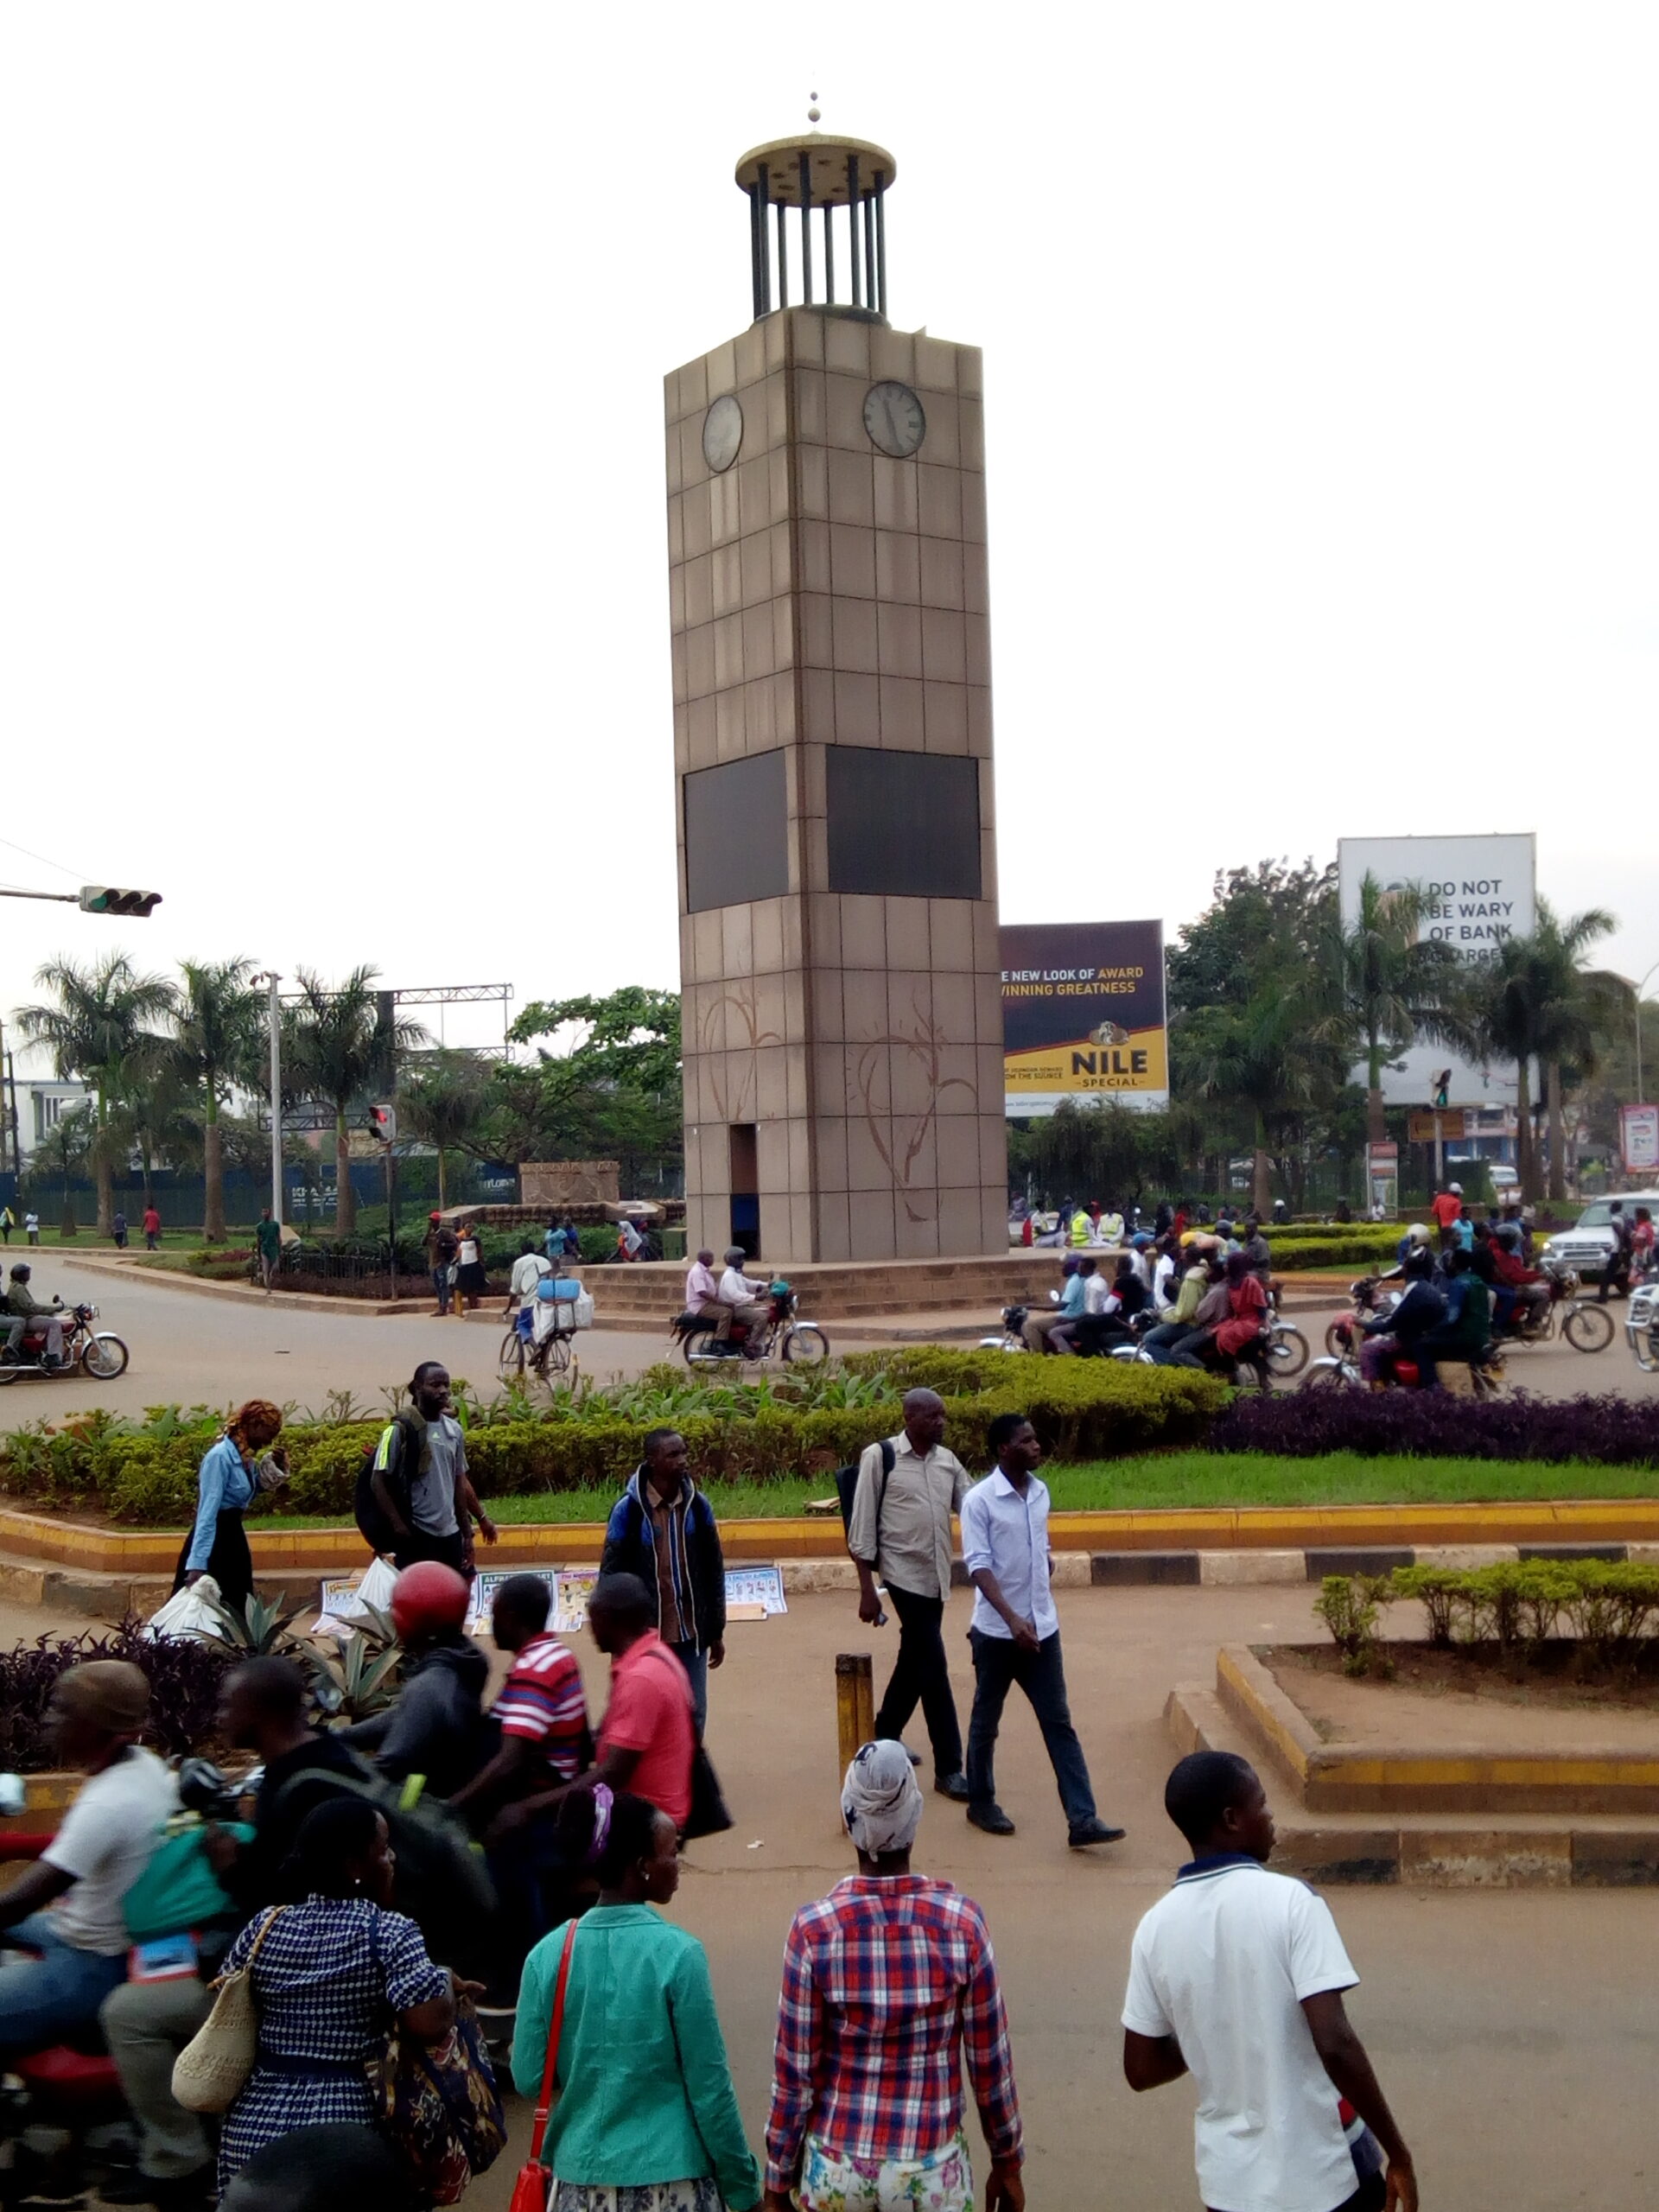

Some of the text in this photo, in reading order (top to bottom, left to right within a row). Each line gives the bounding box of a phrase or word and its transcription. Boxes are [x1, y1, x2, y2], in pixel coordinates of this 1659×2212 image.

[1428, 880, 1503, 897] DO NOT
[1429, 901, 1514, 919] BE WARY
[1429, 924, 1513, 940] OF BANK
[1012, 969, 1041, 982] NEW
[1043, 969, 1077, 982] LOOK
[1079, 968, 1096, 980] OF
[1097, 967, 1144, 979] AWARD
[1057, 982, 1136, 995] GREATNESS
[1071, 1049, 1148, 1075] NILE
[1082, 1077, 1138, 1088] SPECIAL
